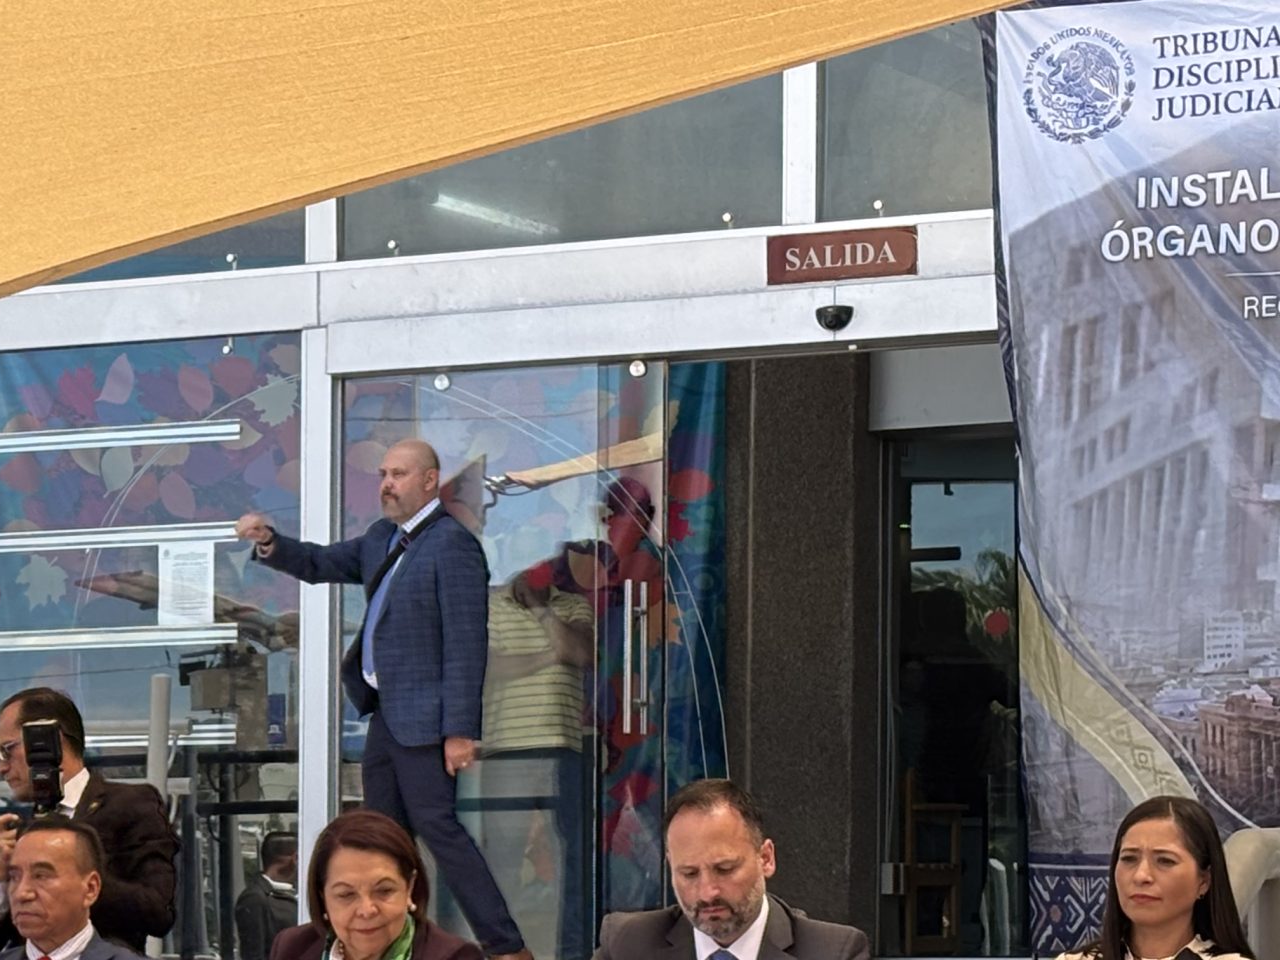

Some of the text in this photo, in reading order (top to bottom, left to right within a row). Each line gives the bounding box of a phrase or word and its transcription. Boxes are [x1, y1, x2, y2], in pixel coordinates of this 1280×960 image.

[1152, 25, 1280, 59] TRIBUNA
[1152, 55, 1280, 90] DISCIPLI
[1152, 87, 1280, 121] JUDICIA
[1137, 167, 1280, 209] INSTAL
[785, 240, 897, 271] SALIDA
[1101, 218, 1280, 263] ÓRGANO
[1244, 295, 1280, 319] RE
